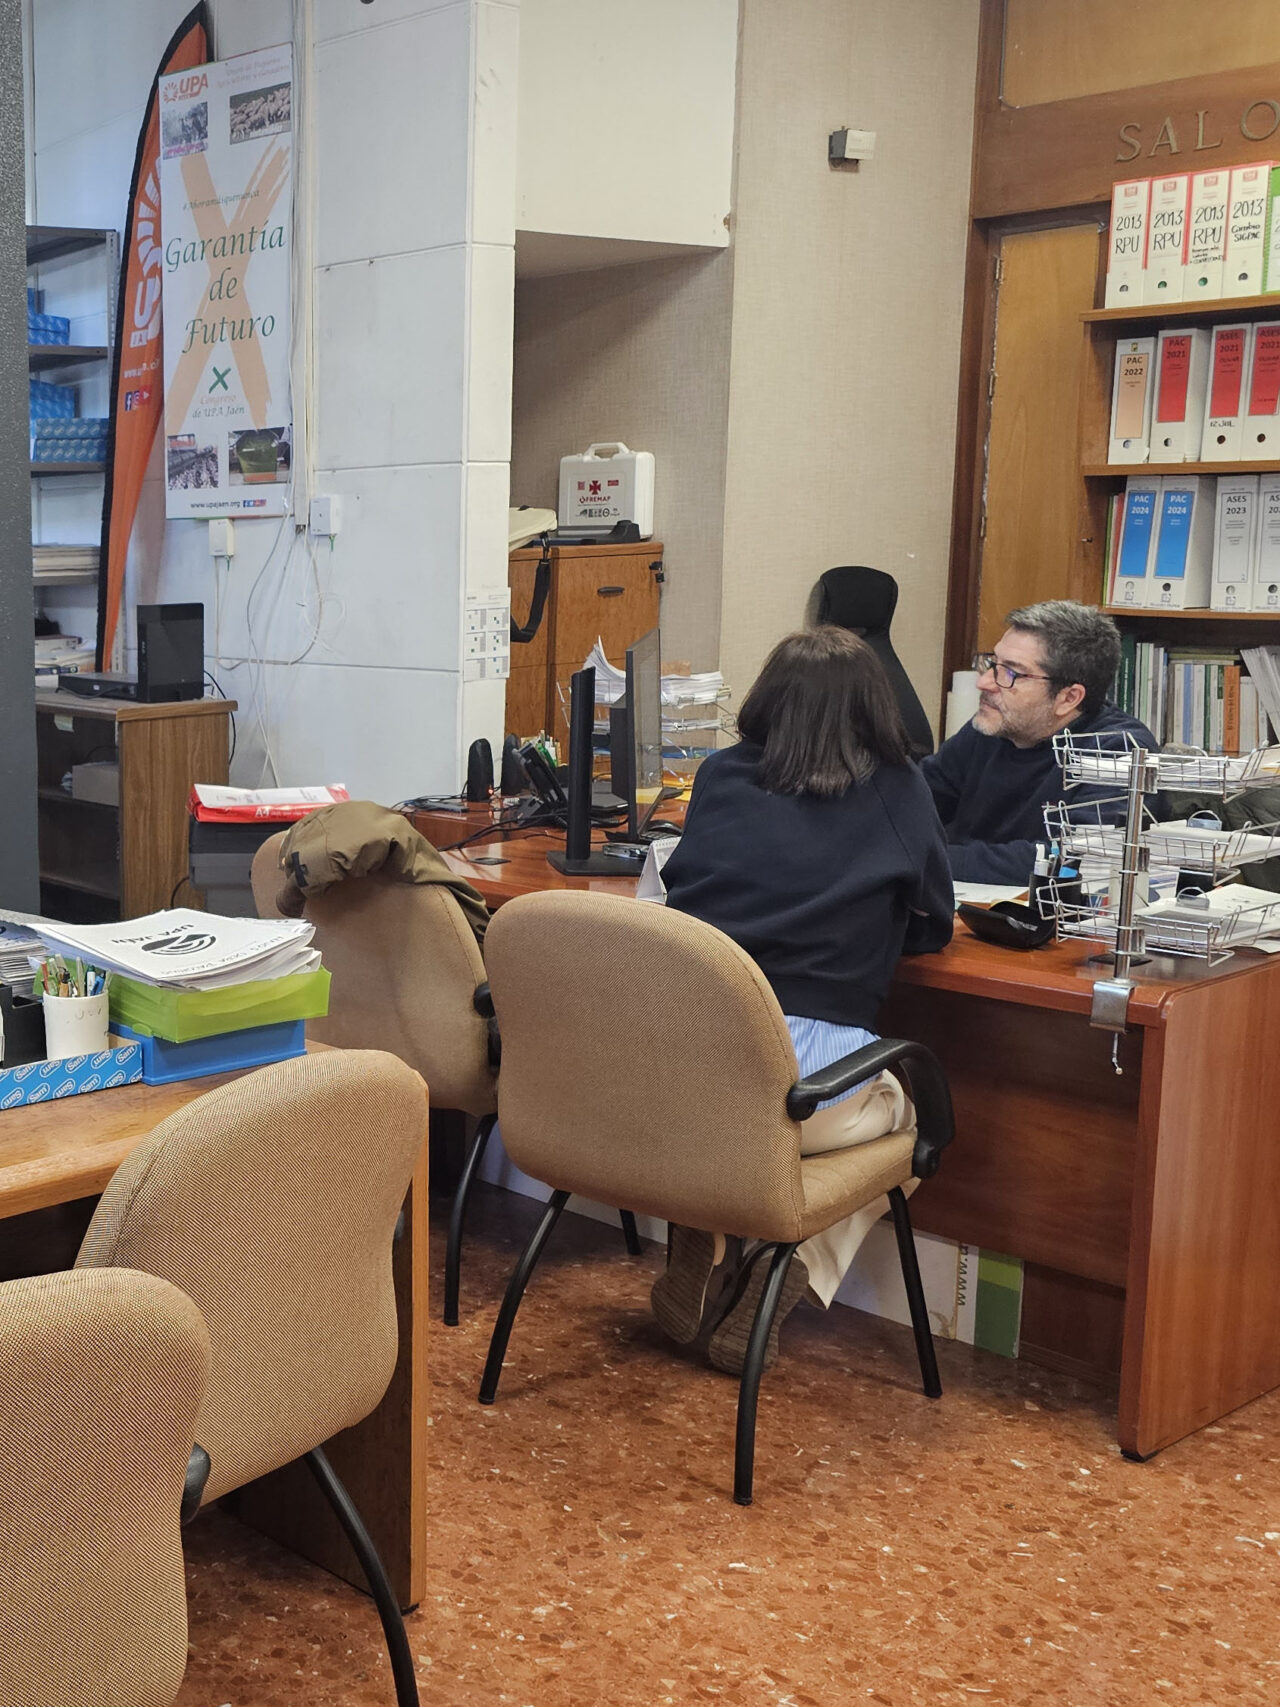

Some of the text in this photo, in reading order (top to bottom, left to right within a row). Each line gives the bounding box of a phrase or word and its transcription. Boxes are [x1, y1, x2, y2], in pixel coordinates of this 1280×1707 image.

[179, 73, 208, 94] UPA
[1194, 204, 1225, 223] 2013
[1232, 198, 1264, 219] 2013
[1116, 213, 1142, 231] 2013
[1153, 209, 1183, 228] 2013
[1153, 231, 1182, 251] RPU
[1192, 226, 1222, 245] RPU
[165, 220, 286, 273] Garantía
[1115, 236, 1139, 254] RPU
[209, 266, 238, 301] de
[181, 314, 275, 354] Futuro
[1169, 339, 1185, 347] PAC
[1126, 356, 1143, 364] PAC
[1166, 350, 1186, 359] 2021
[1124, 368, 1144, 376] 2022
[1134, 495, 1149, 503] PAC
[1170, 495, 1187, 503] PAC
[1226, 495, 1247, 503] ASES
[1131, 506, 1150, 515] 2024
[1167, 506, 1187, 515] 2024
[1226, 506, 1247, 515] 2023
[93, 1050, 111, 1065] Sam
[118, 1046, 135, 1061] Sam
[68, 1056, 86, 1070] Sam
[81, 1077, 98, 1093] Sam
[106, 1073, 123, 1088] Sam
[29, 1086, 47, 1102] Sam
[56, 1081, 73, 1097] Sam
[4, 1090, 22, 1107] Sam
